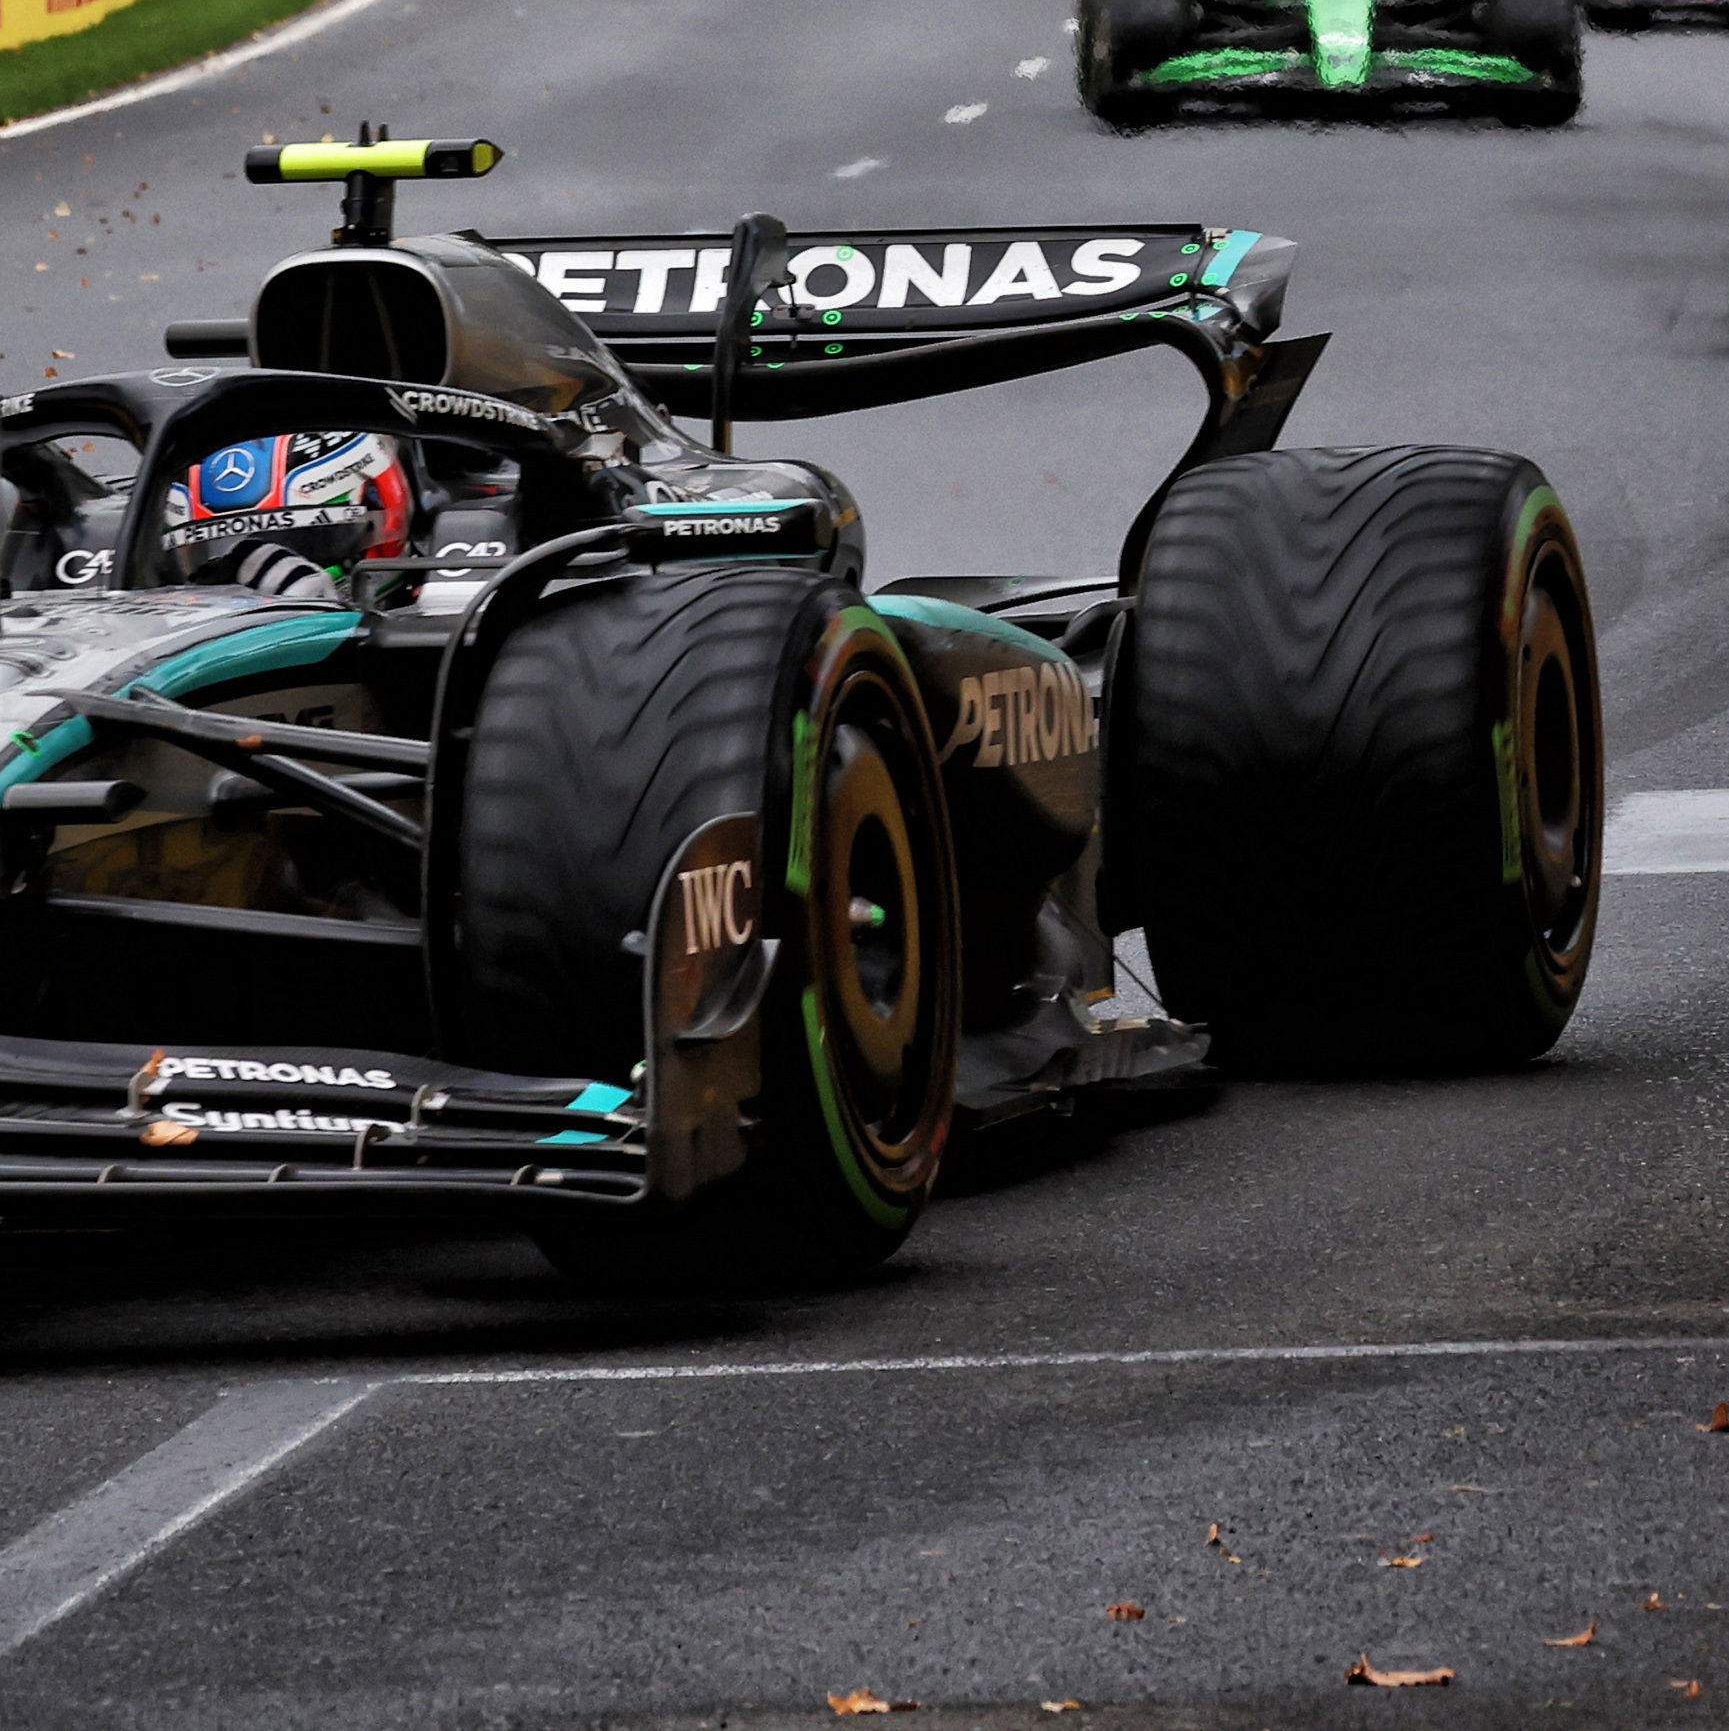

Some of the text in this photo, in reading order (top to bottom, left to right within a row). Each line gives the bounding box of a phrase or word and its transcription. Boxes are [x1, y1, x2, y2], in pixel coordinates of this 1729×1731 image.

[184, 511, 296, 542] PETRONAS
[663, 516, 782, 537] PETRONAS
[676, 860, 753, 956] IWC
[157, 1057, 398, 1090] PETRONAS
[161, 1101, 407, 1132] Syntium
